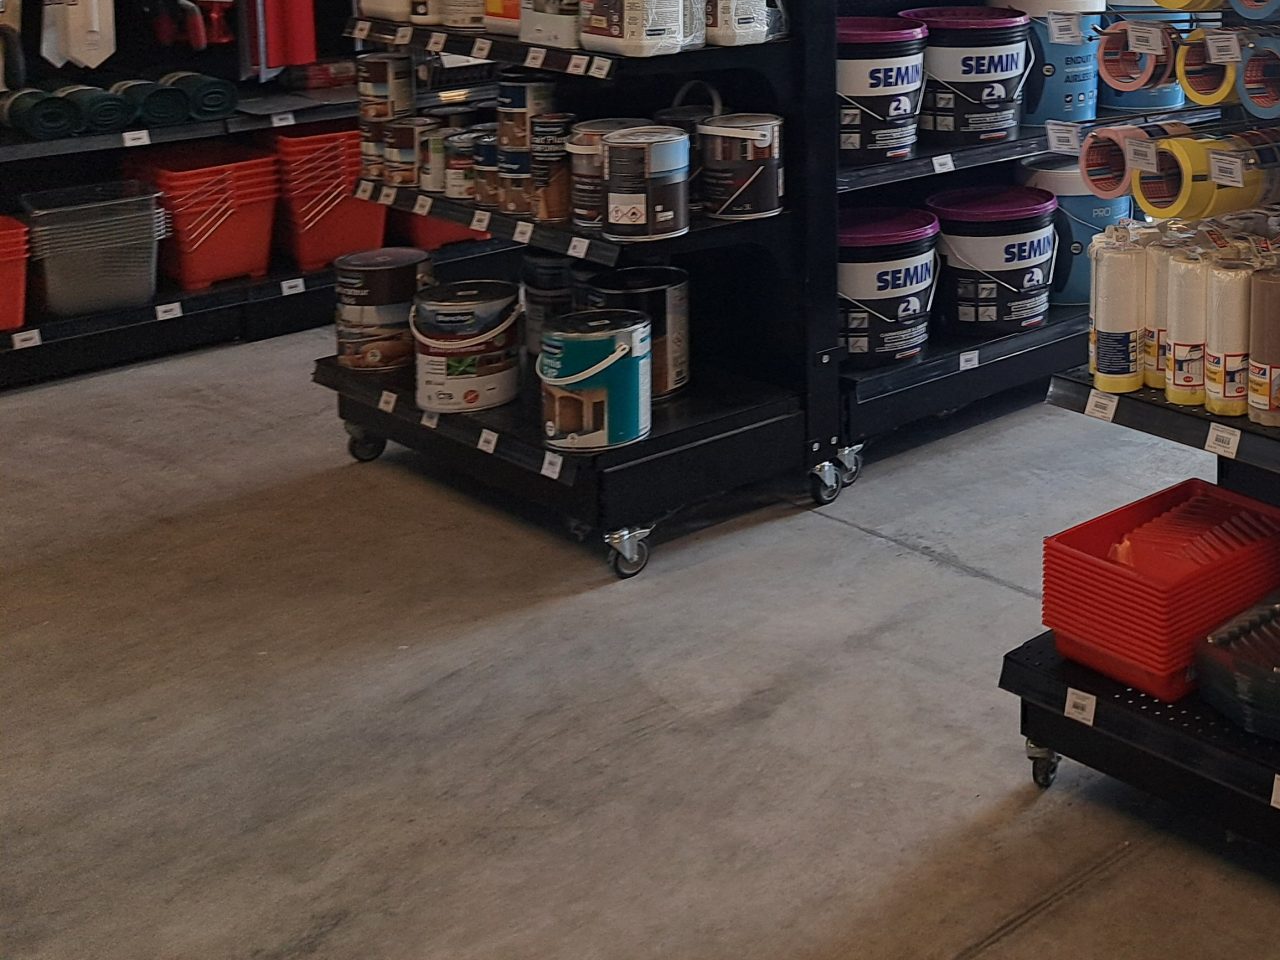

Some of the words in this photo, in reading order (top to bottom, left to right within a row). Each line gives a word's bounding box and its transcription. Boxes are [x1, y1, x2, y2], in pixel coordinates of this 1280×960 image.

[961, 52, 1020, 75] SEMIN
[1064, 55, 1092, 66] ENDUIT
[869, 63, 920, 89] SEMIN
[1004, 235, 1052, 263] SEMIN
[876, 259, 932, 291] SEMIN
